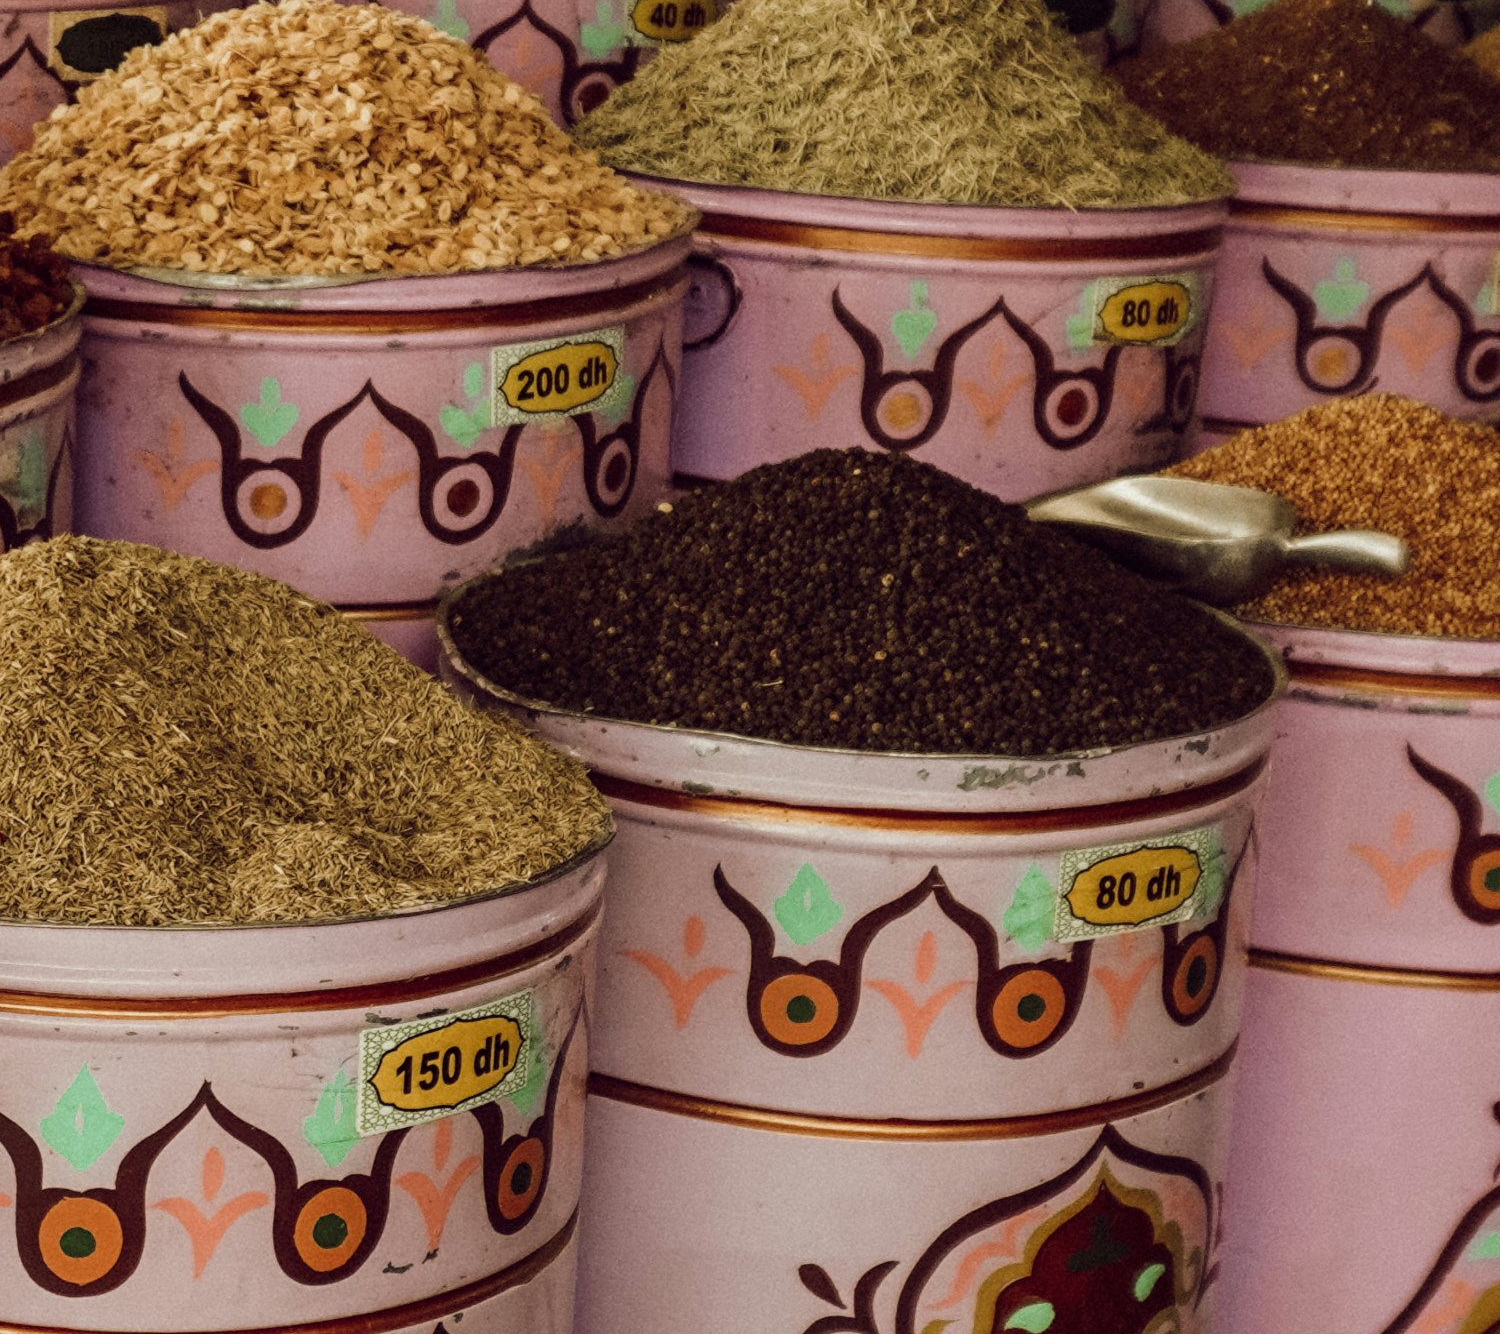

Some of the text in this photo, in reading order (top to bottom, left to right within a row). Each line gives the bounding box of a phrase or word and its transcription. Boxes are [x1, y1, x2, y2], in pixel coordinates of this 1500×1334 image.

[649, 3, 678, 28] 40
[1121, 297, 1179, 328] 80 dh
[517, 356, 607, 401] 200 dh
[1096, 864, 1181, 910] 80 dh
[396, 1032, 511, 1095] 150 dh
